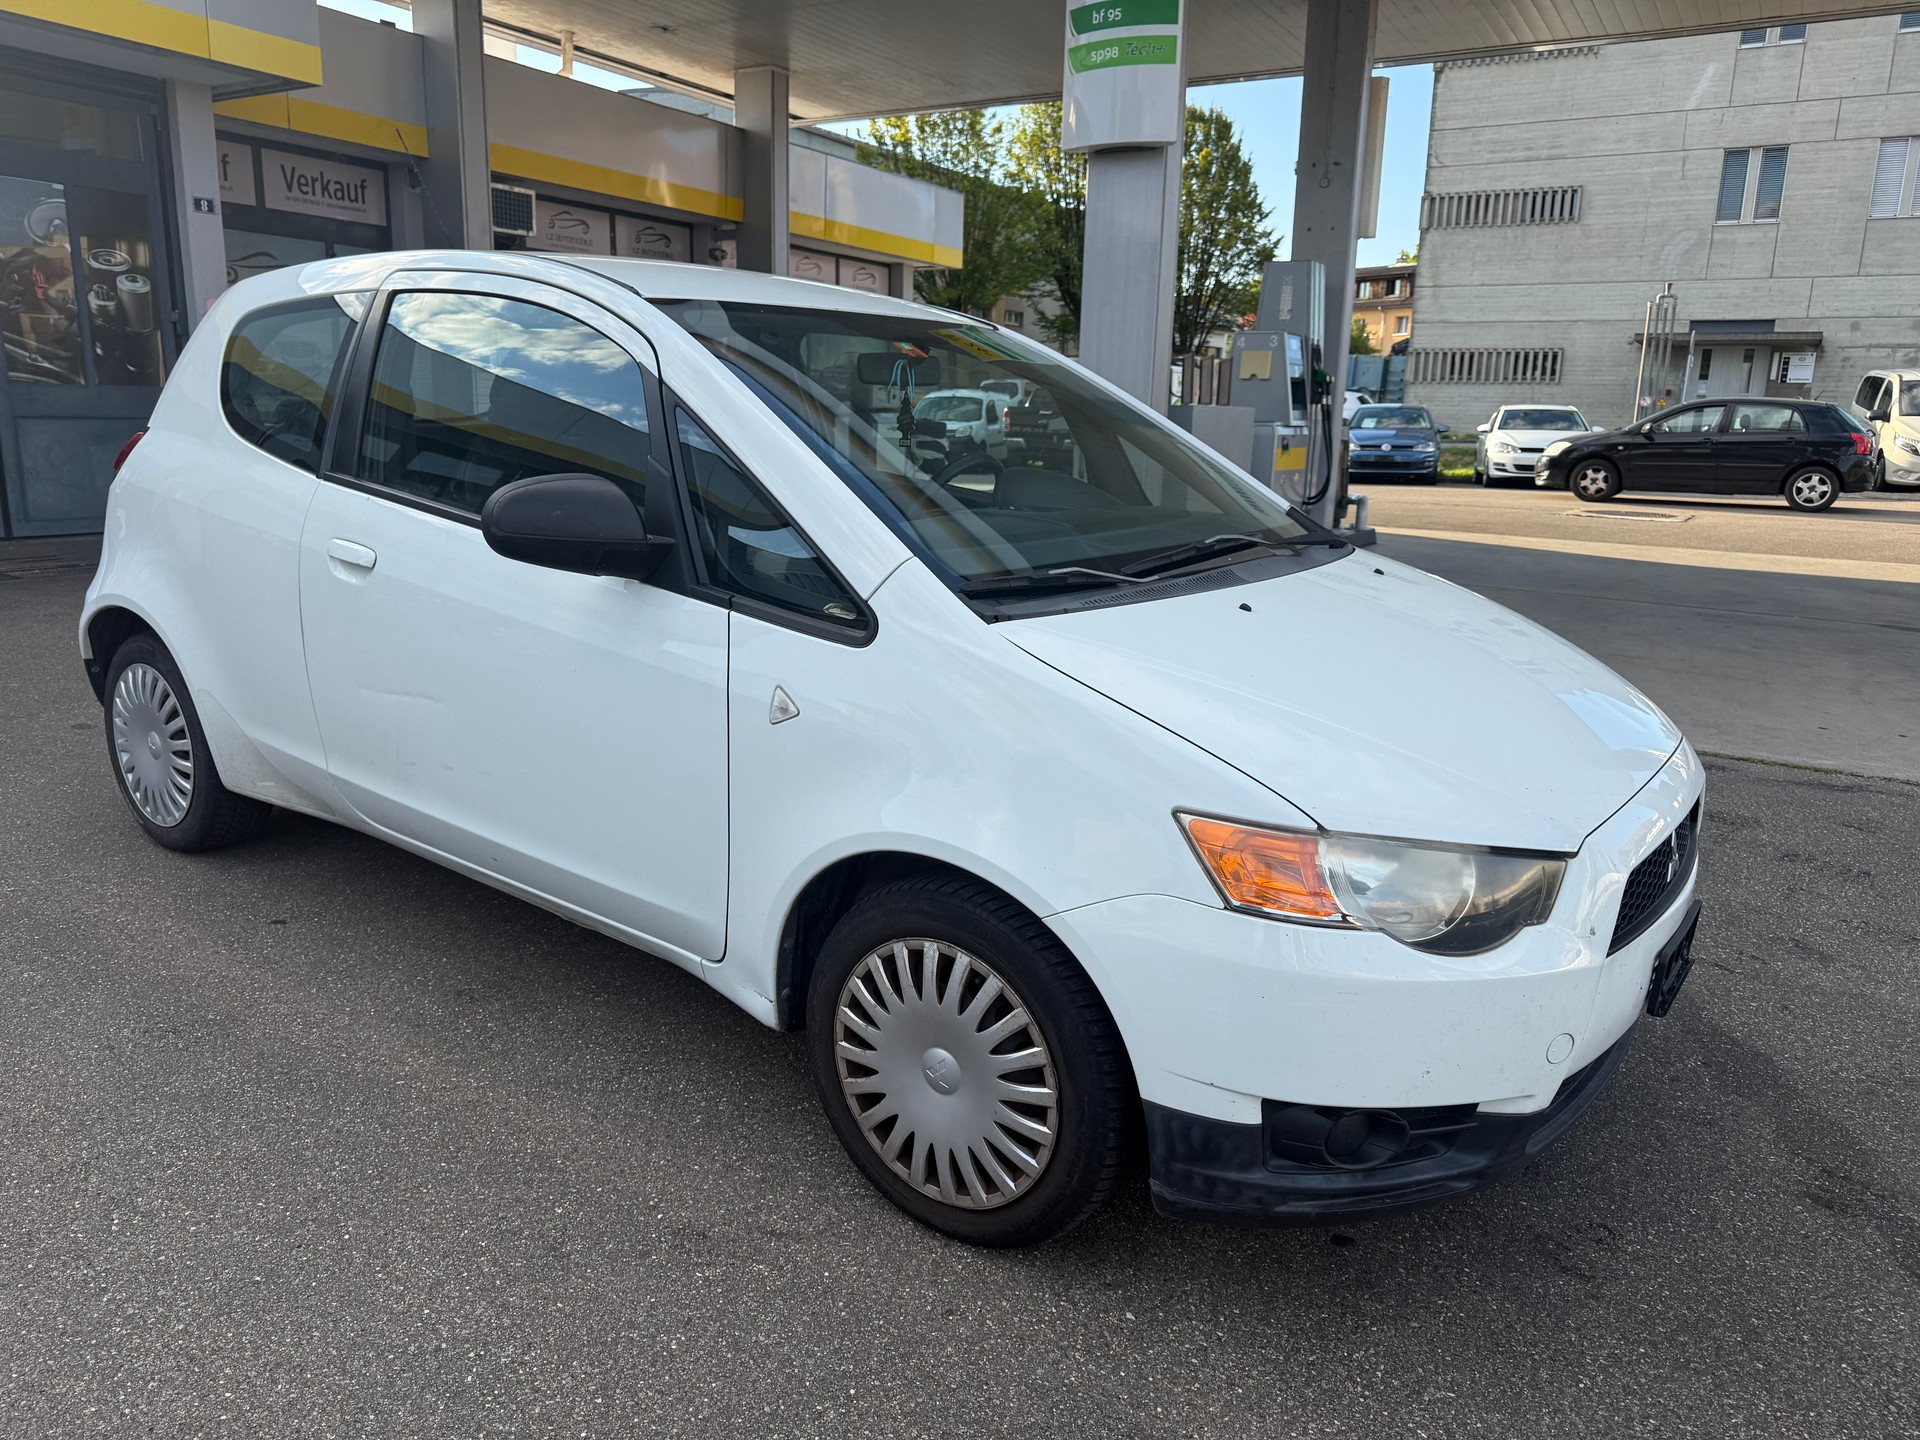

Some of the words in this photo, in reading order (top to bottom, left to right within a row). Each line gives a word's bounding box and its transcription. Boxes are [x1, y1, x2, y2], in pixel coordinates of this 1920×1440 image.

[1092, 9, 1106, 24] bf
[1107, 8, 1122, 21] 95
[1091, 46, 1119, 64] sp98
[1125, 42, 1166, 56] Tech+
[280, 163, 367, 205] Verkauf
[200, 199, 208, 211] 8
[1236, 336, 1245, 349] 4
[1268, 335, 1278, 347] 3
